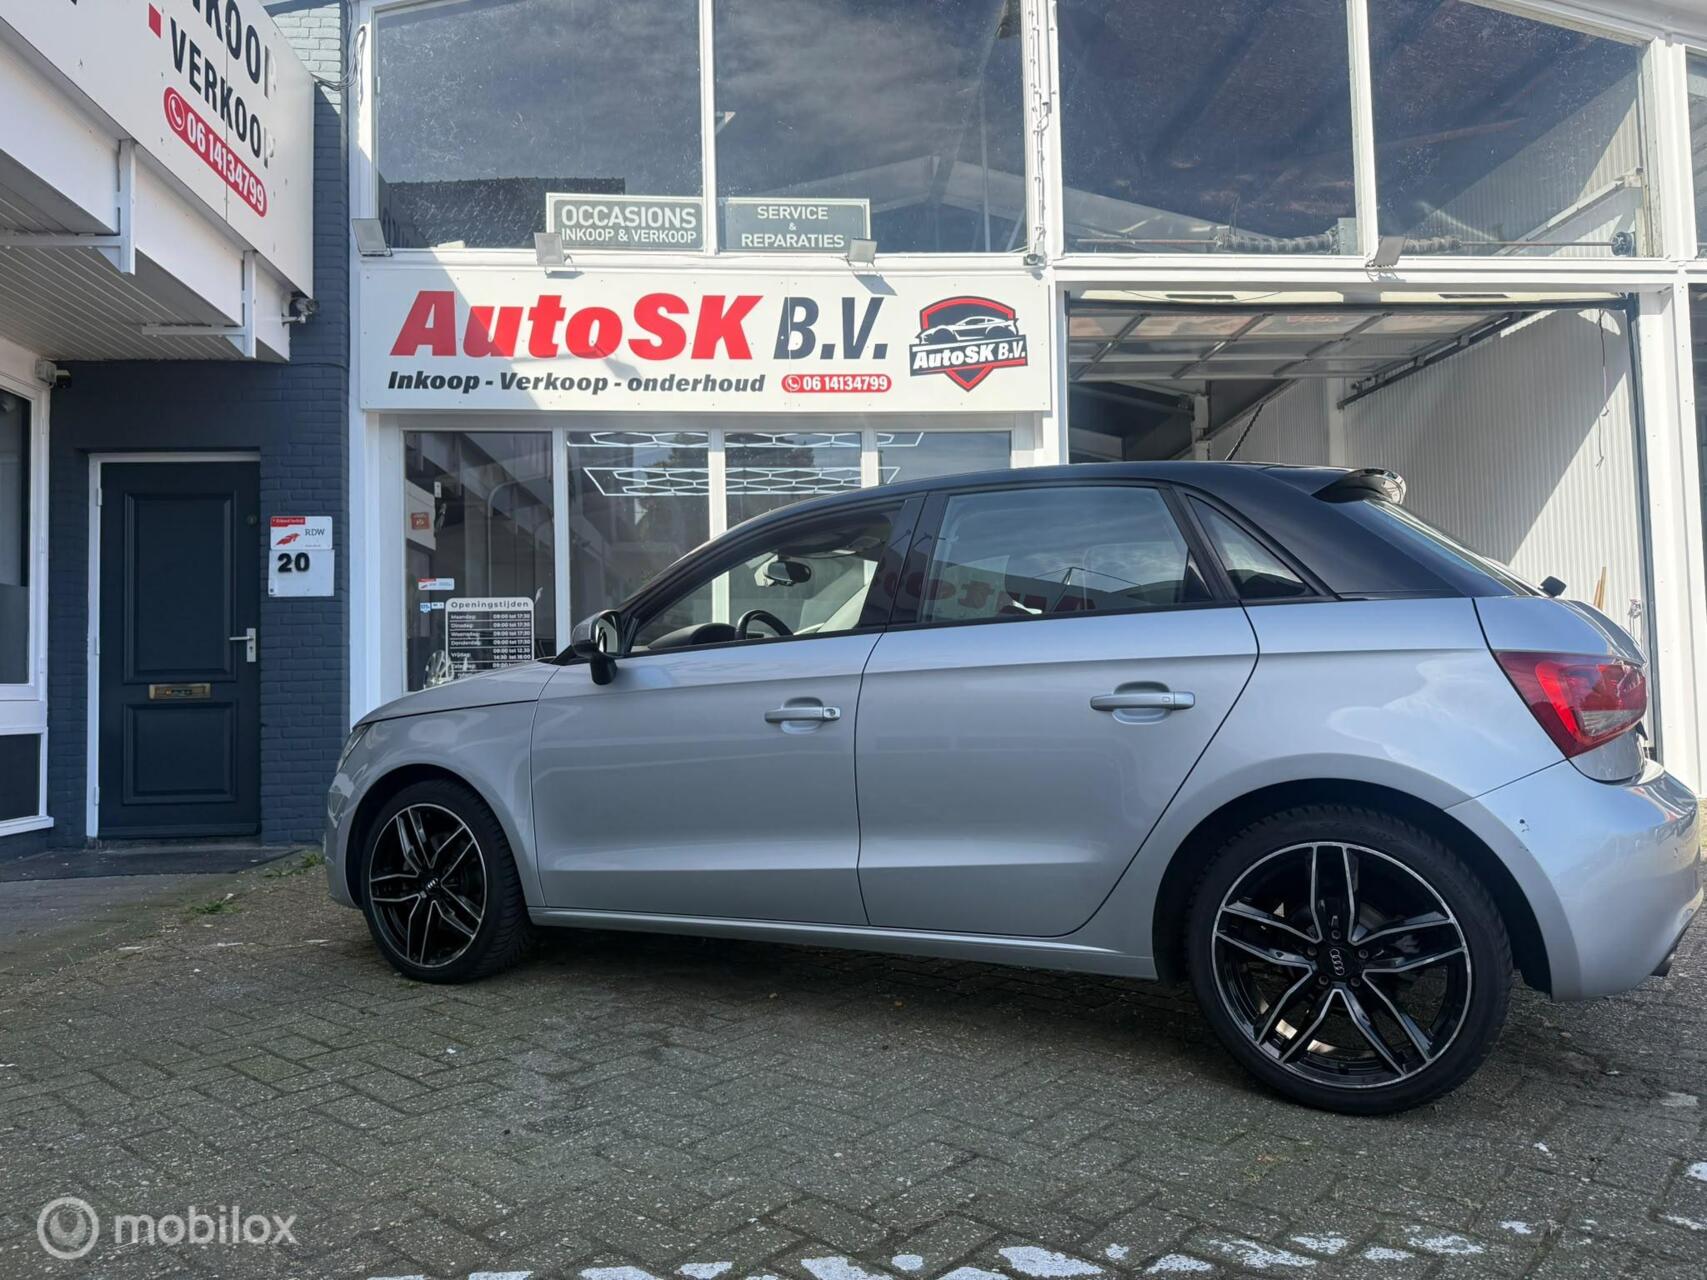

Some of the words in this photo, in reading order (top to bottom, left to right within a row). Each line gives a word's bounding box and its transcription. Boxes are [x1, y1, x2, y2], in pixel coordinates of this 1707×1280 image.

[187, 116, 207, 152] 06
[209, 134, 265, 214] 14134799
[561, 204, 697, 228] OCCASIONS
[757, 206, 829, 220] SERVICE
[788, 222, 797, 231] &
[561, 229, 614, 242] INKOOP
[618, 229, 628, 242] &
[632, 230, 697, 244] VERKOOP
[742, 233, 845, 248] REPARATIES
[389, 290, 764, 361] AutoSK
[773, 297, 889, 360] B.V.
[913, 343, 995, 369] AutoSK
[997, 341, 1026, 360] B.V.
[388, 371, 480, 394] Inkoop
[500, 372, 609, 395] Verkoop
[628, 374, 765, 393] onderhoud
[803, 376, 821, 391] 06
[824, 376, 888, 391] 14134799
[277, 552, 310, 573] 20
[450, 600, 529, 609] Openingstijden
